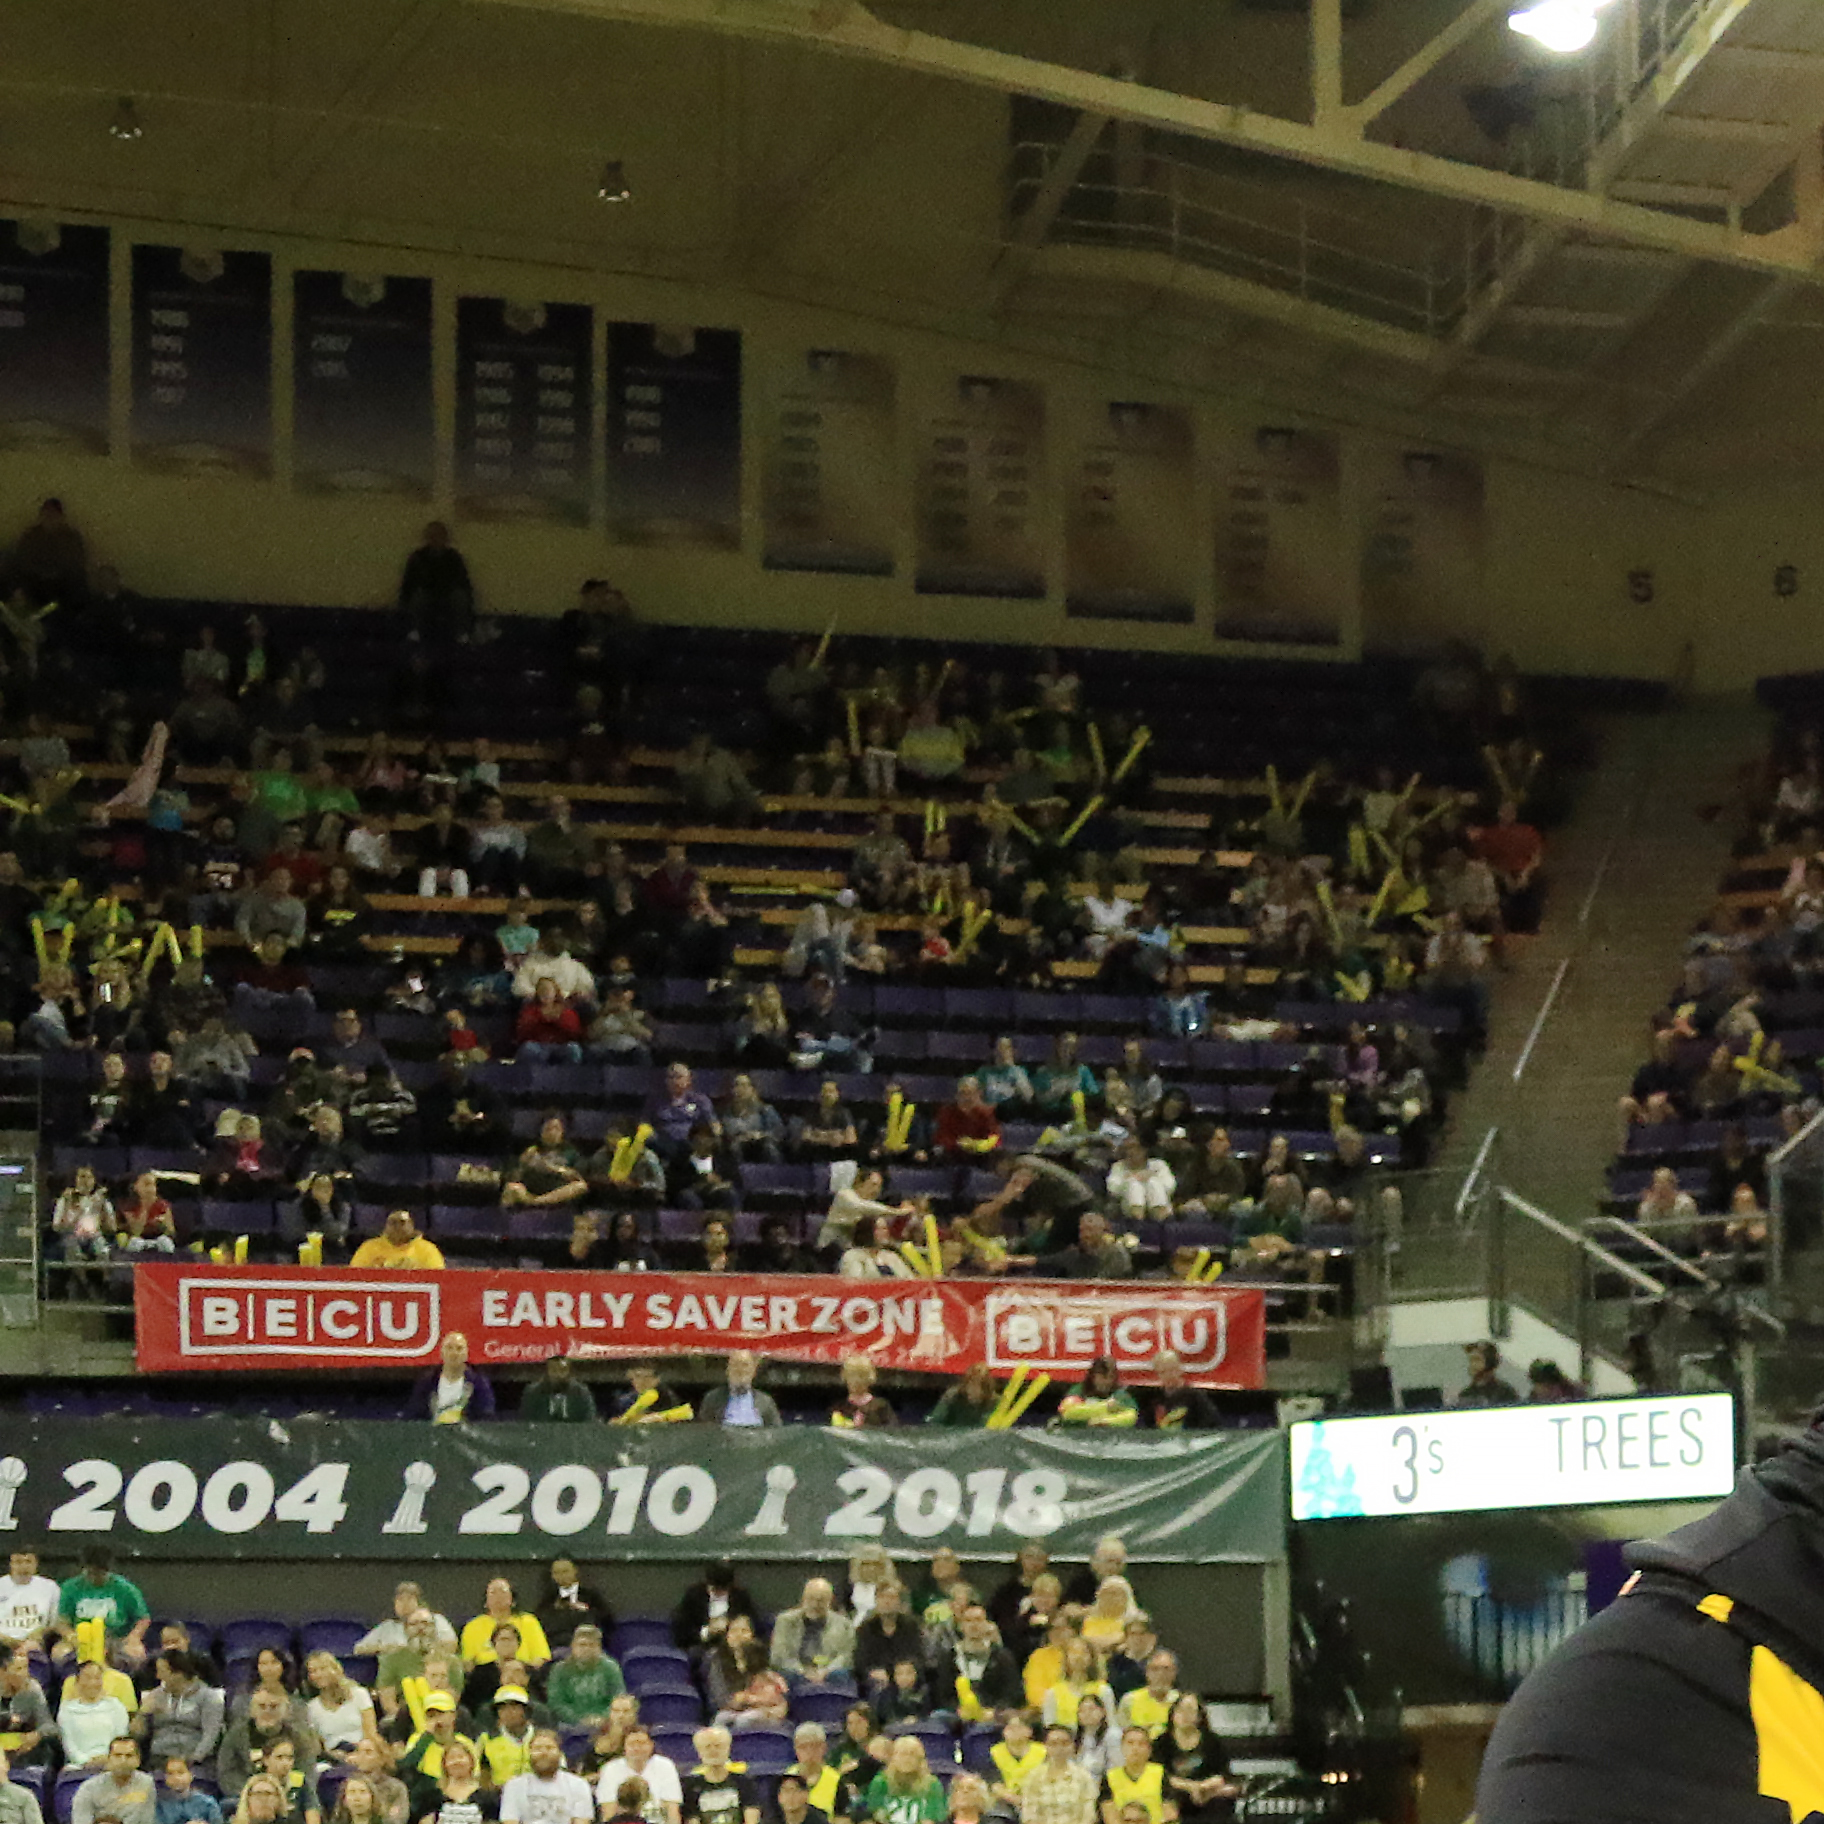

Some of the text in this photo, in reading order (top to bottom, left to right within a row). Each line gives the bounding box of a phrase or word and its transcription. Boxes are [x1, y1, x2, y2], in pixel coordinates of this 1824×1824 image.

[202, 1295, 420, 1342] BECU
[481, 1289, 944, 1336] EARLY SAVER ZONE
[1006, 1313, 1210, 1355] BECU
[1549, 1407, 1706, 1475] TREES
[49, 1458, 1068, 1538] 2004 2010 2018
